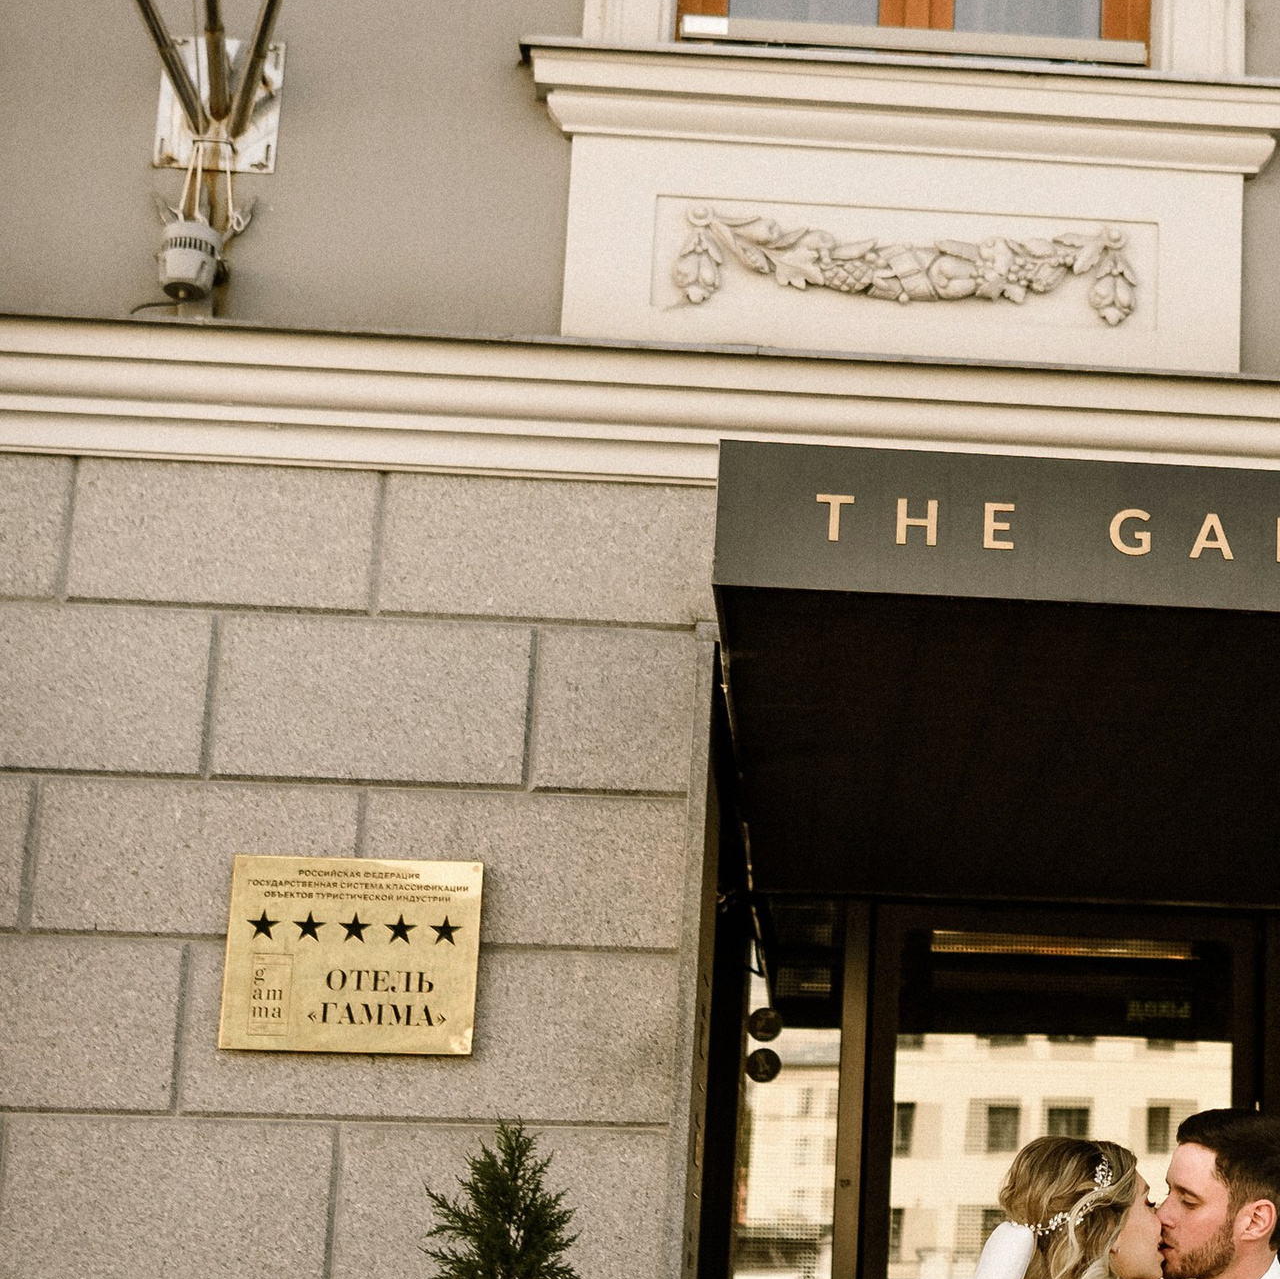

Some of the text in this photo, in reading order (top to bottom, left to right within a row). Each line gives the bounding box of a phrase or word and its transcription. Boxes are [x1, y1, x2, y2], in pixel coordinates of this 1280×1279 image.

[815, 492, 1016, 551] THE
[298, 869, 421, 880] РОССИЙСКАЯ ФЕДЕРАЦИЯ
[247, 879, 469, 893] ГОСУДАРСТВЕННАЯ СИСТЕМА КЛАССИФИКАЦИИ
[264, 891, 314, 899] ОБЪЕКТОВ
[325, 968, 435, 994] ОТЕЛЬ
[306, 1001, 447, 1028] «ГАММА»
